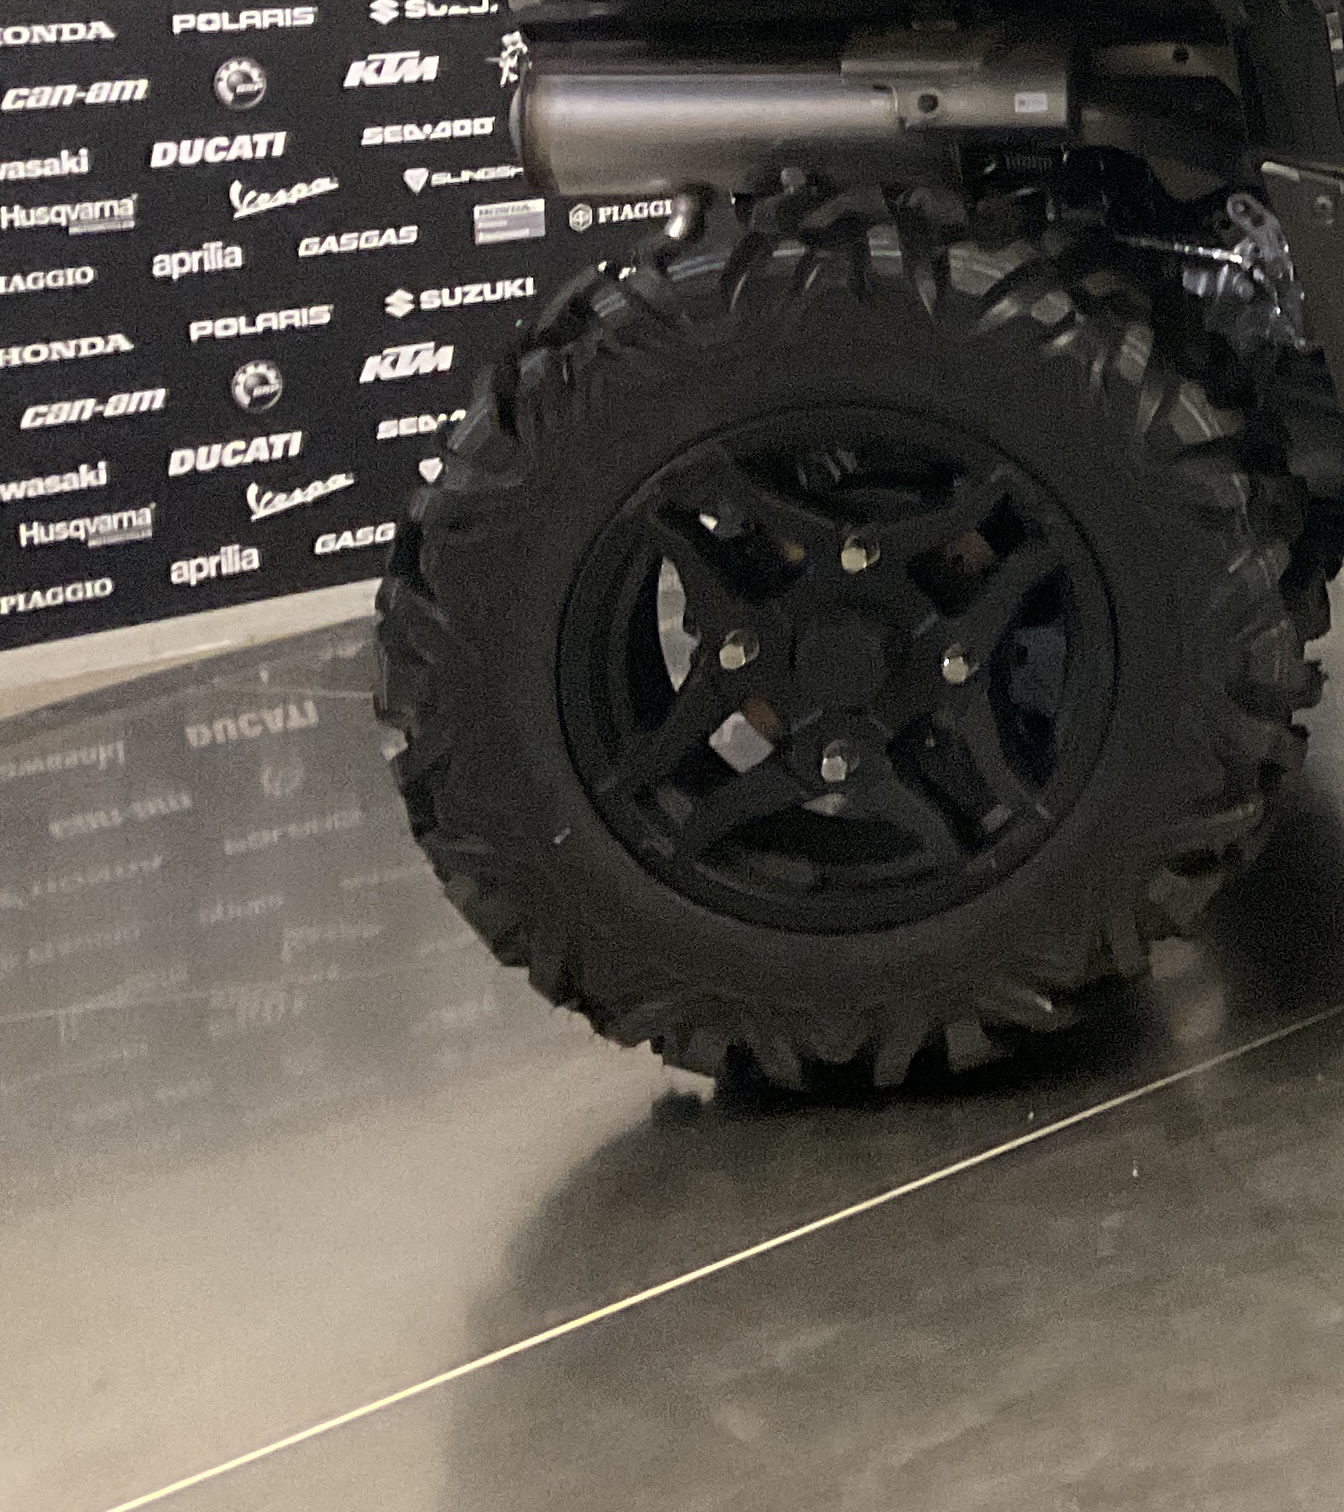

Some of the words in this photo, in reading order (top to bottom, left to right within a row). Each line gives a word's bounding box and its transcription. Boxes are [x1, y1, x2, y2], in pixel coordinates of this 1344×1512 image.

[171, 5, 317, 36] POLARIS
[342, 49, 440, 89] KTM
[0, 77, 150, 112] can-am
[149, 130, 288, 169] DUCATI
[0, 196, 136, 230] Husqvarna
[229, 176, 340, 220] Vespa
[597, 198, 675, 225] PIAGGI
[297, 224, 419, 258] GASGAS
[0, 265, 95, 295] IAGGIO
[151, 240, 244, 282] aprilia
[419, 276, 537, 311] SUZUKI
[189, 304, 331, 343] POLARIS
[0, 332, 135, 369] HONDA
[358, 340, 455, 384] KTM
[19, 387, 167, 430] can-am
[167, 430, 303, 477] DUCATI
[0, 460, 108, 502] wasaki
[246, 472, 355, 523] Vespa
[18, 504, 153, 547] Husqvarna
[170, 543, 261, 587] aprilia
[0, 577, 114, 615] PIAGGIO
